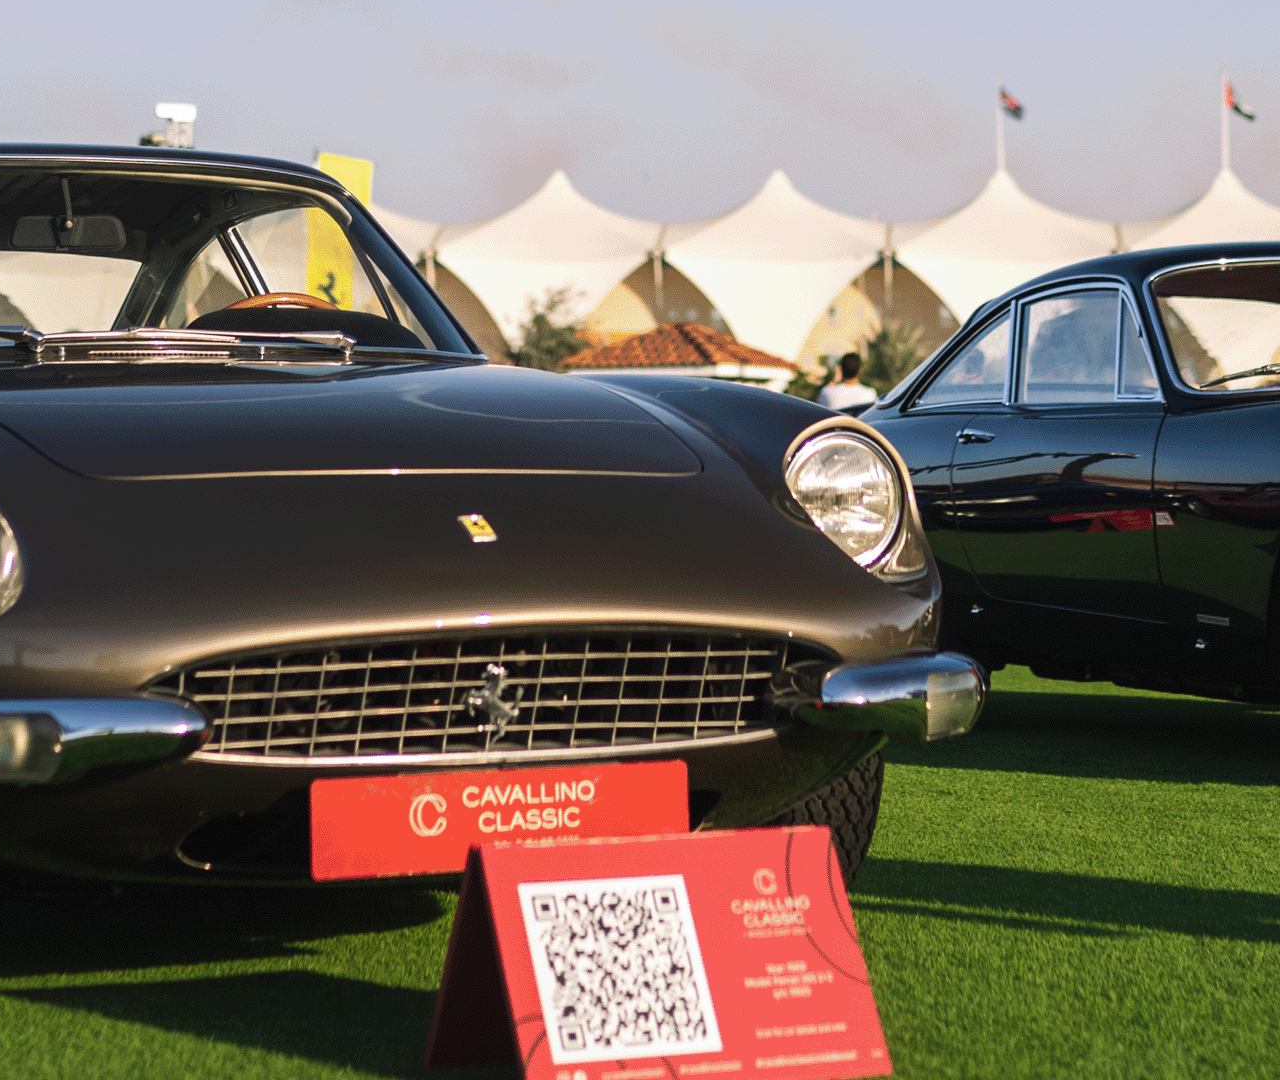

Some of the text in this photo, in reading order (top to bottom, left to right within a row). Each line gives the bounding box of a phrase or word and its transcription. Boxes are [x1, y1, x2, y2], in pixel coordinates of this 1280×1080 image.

[462, 780, 595, 808] CAVALLINO
[478, 806, 581, 833] CLASSIC
[730, 894, 811, 915] CAVALLINO
[743, 911, 806, 929] CLASSIC
